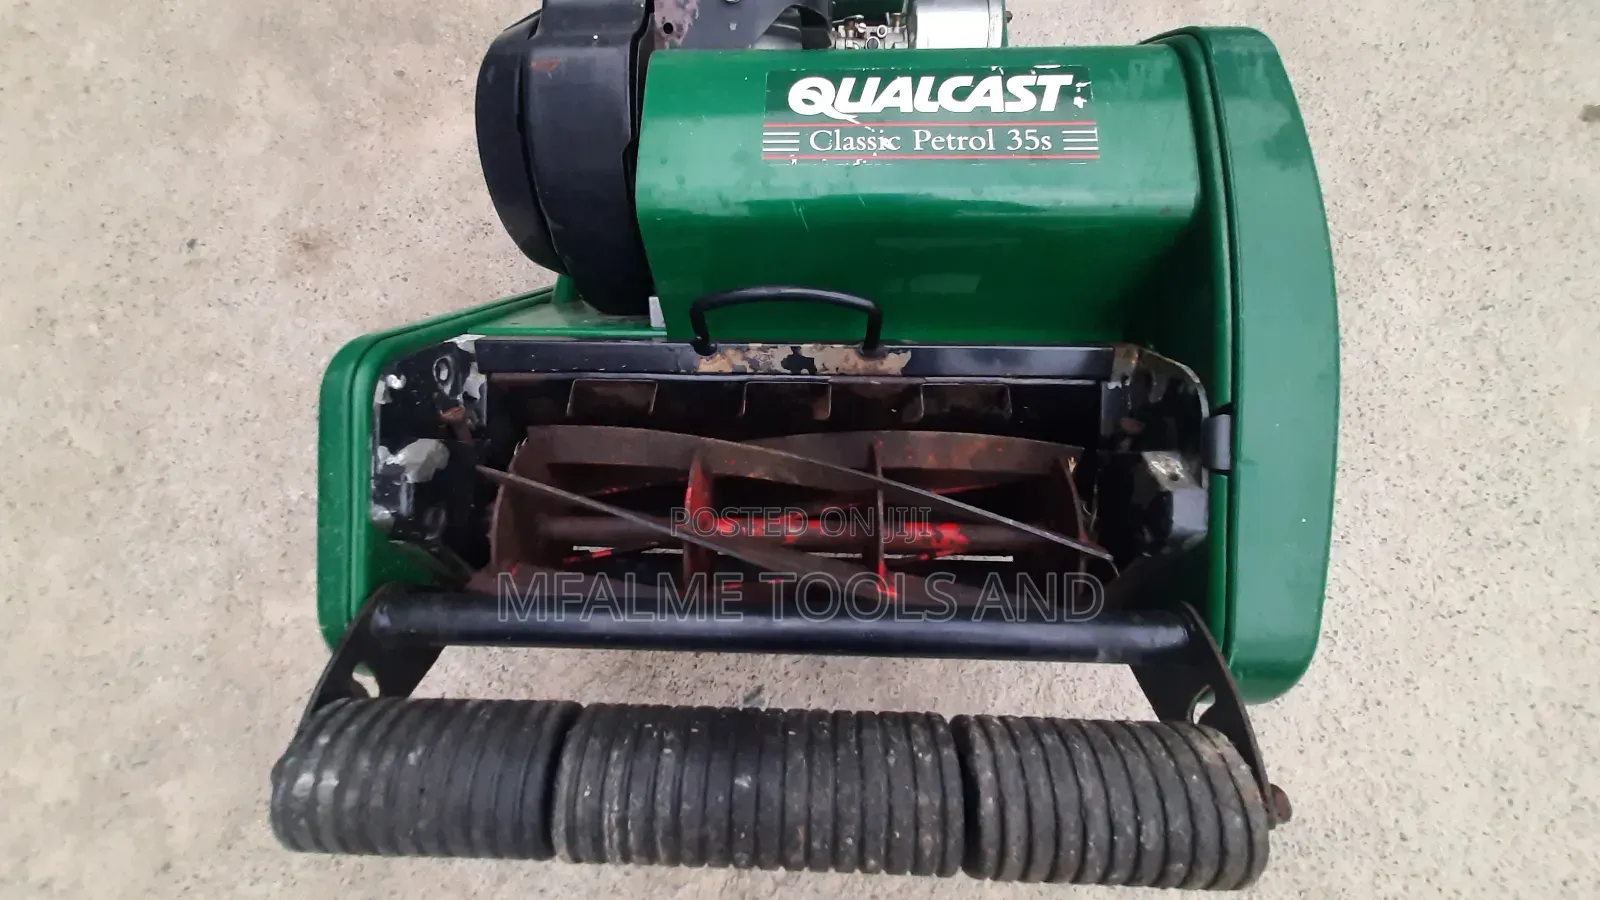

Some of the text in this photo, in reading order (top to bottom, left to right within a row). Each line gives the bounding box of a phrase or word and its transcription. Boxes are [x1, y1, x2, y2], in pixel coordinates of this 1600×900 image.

[787, 74, 1074, 124] QUALCAST
[809, 127, 1053, 151] Classic Petrol 35s
